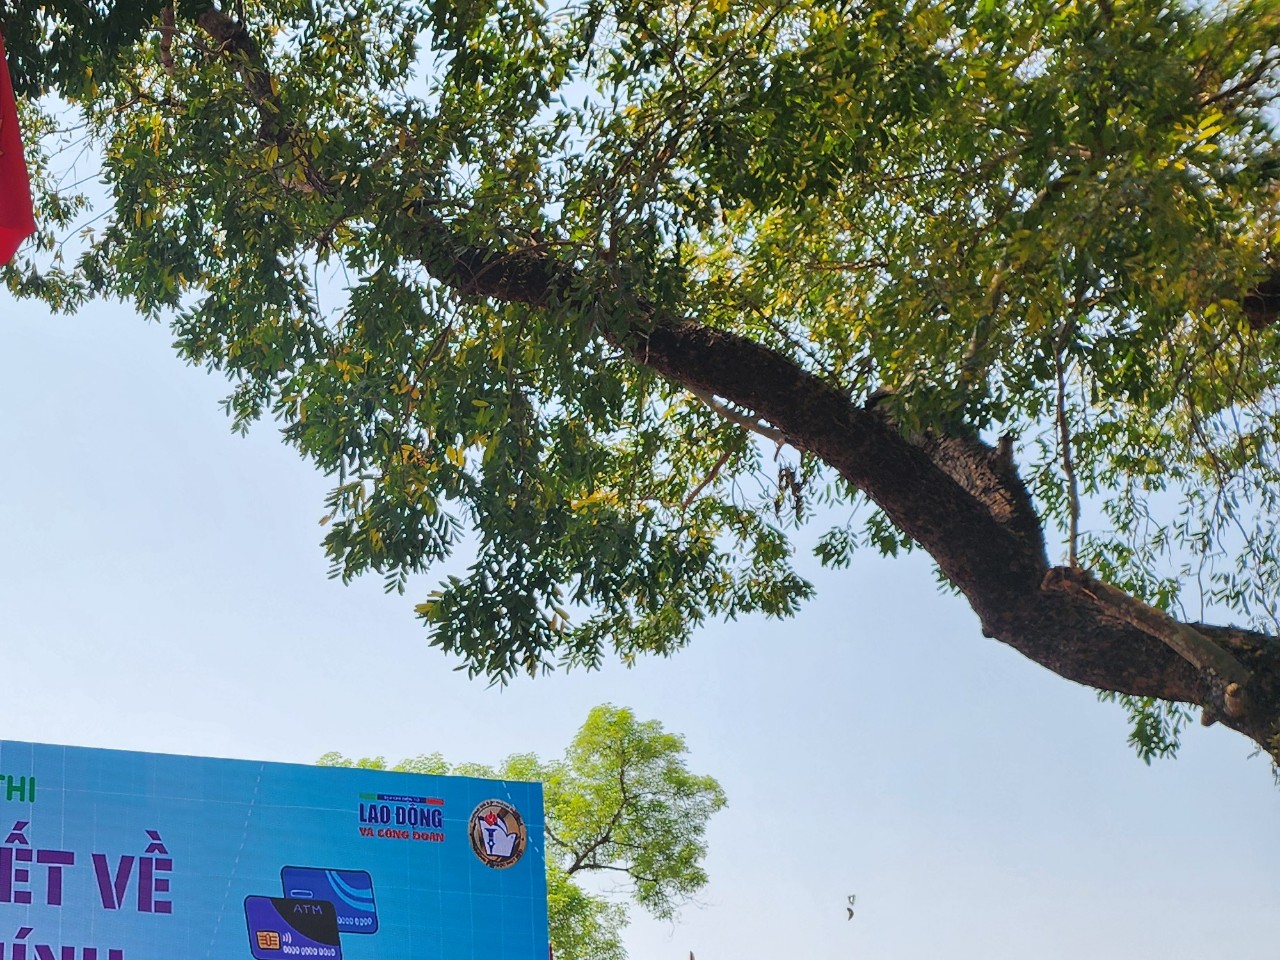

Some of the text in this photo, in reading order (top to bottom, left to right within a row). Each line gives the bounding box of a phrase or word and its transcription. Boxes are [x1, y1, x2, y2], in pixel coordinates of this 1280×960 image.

[359, 801, 443, 830] LAO ĐỘNG
[91, 830, 173, 914] VỀ
[293, 903, 323, 915] ATM
